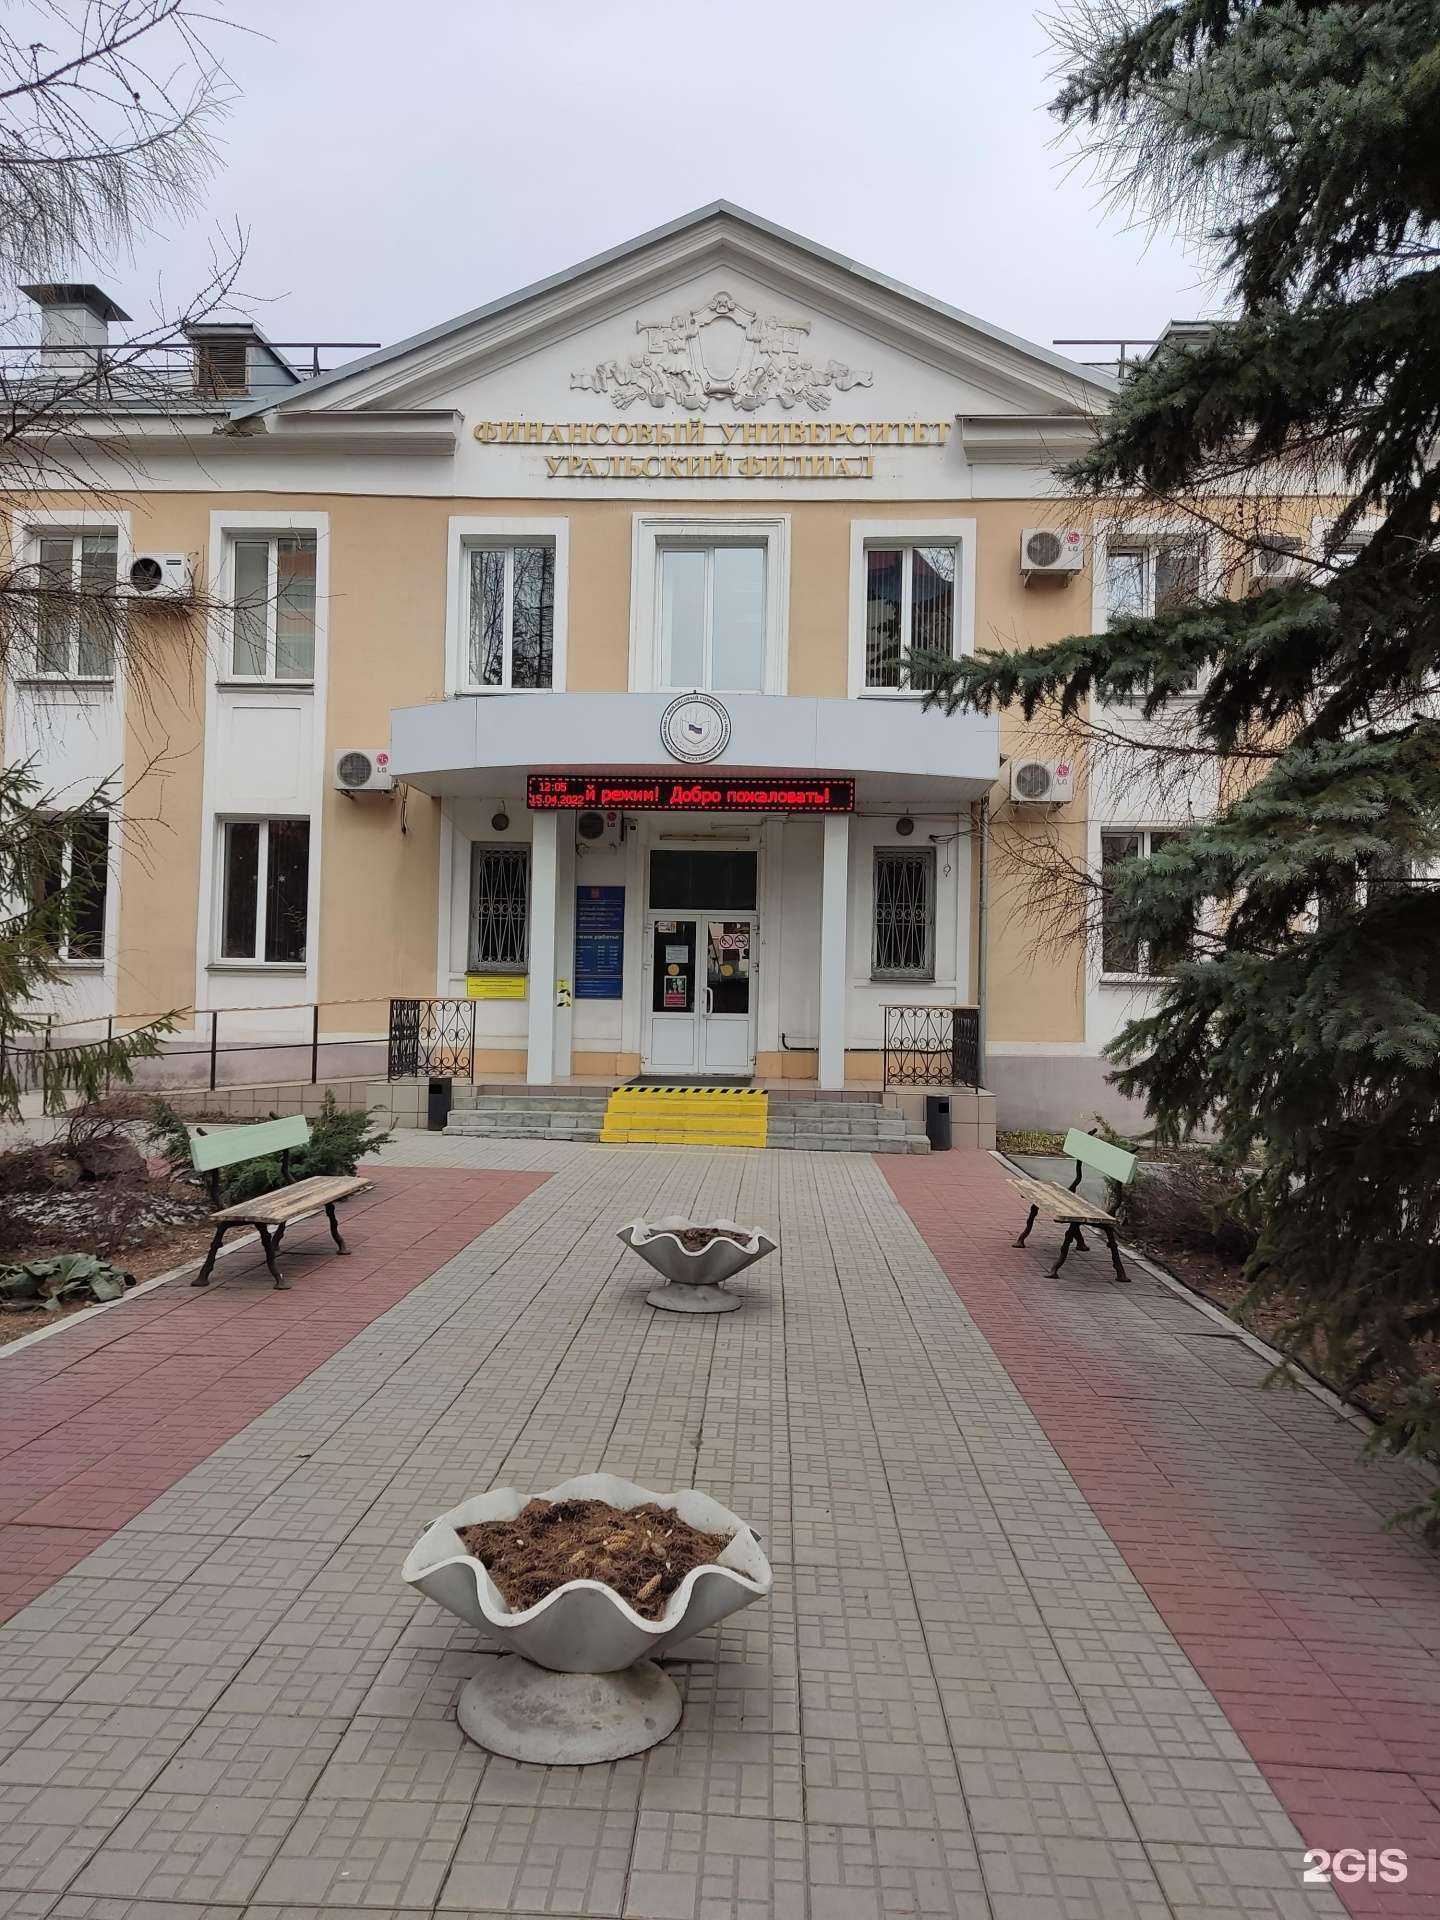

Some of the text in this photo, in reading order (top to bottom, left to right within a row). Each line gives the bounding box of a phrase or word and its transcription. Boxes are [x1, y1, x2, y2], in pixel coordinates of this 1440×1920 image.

[473, 418, 952, 445] ФИНАНСОВЫЙ УНИВЕРСИТЕТ
[544, 450, 876, 477] УРАЛЬСКИЙ ФИЛИАЛ
[539, 782, 567, 792] 12:05
[601, 785, 660, 804] режим!
[670, 785, 722, 806] Добро
[727, 787, 830, 804] пожаловать!
